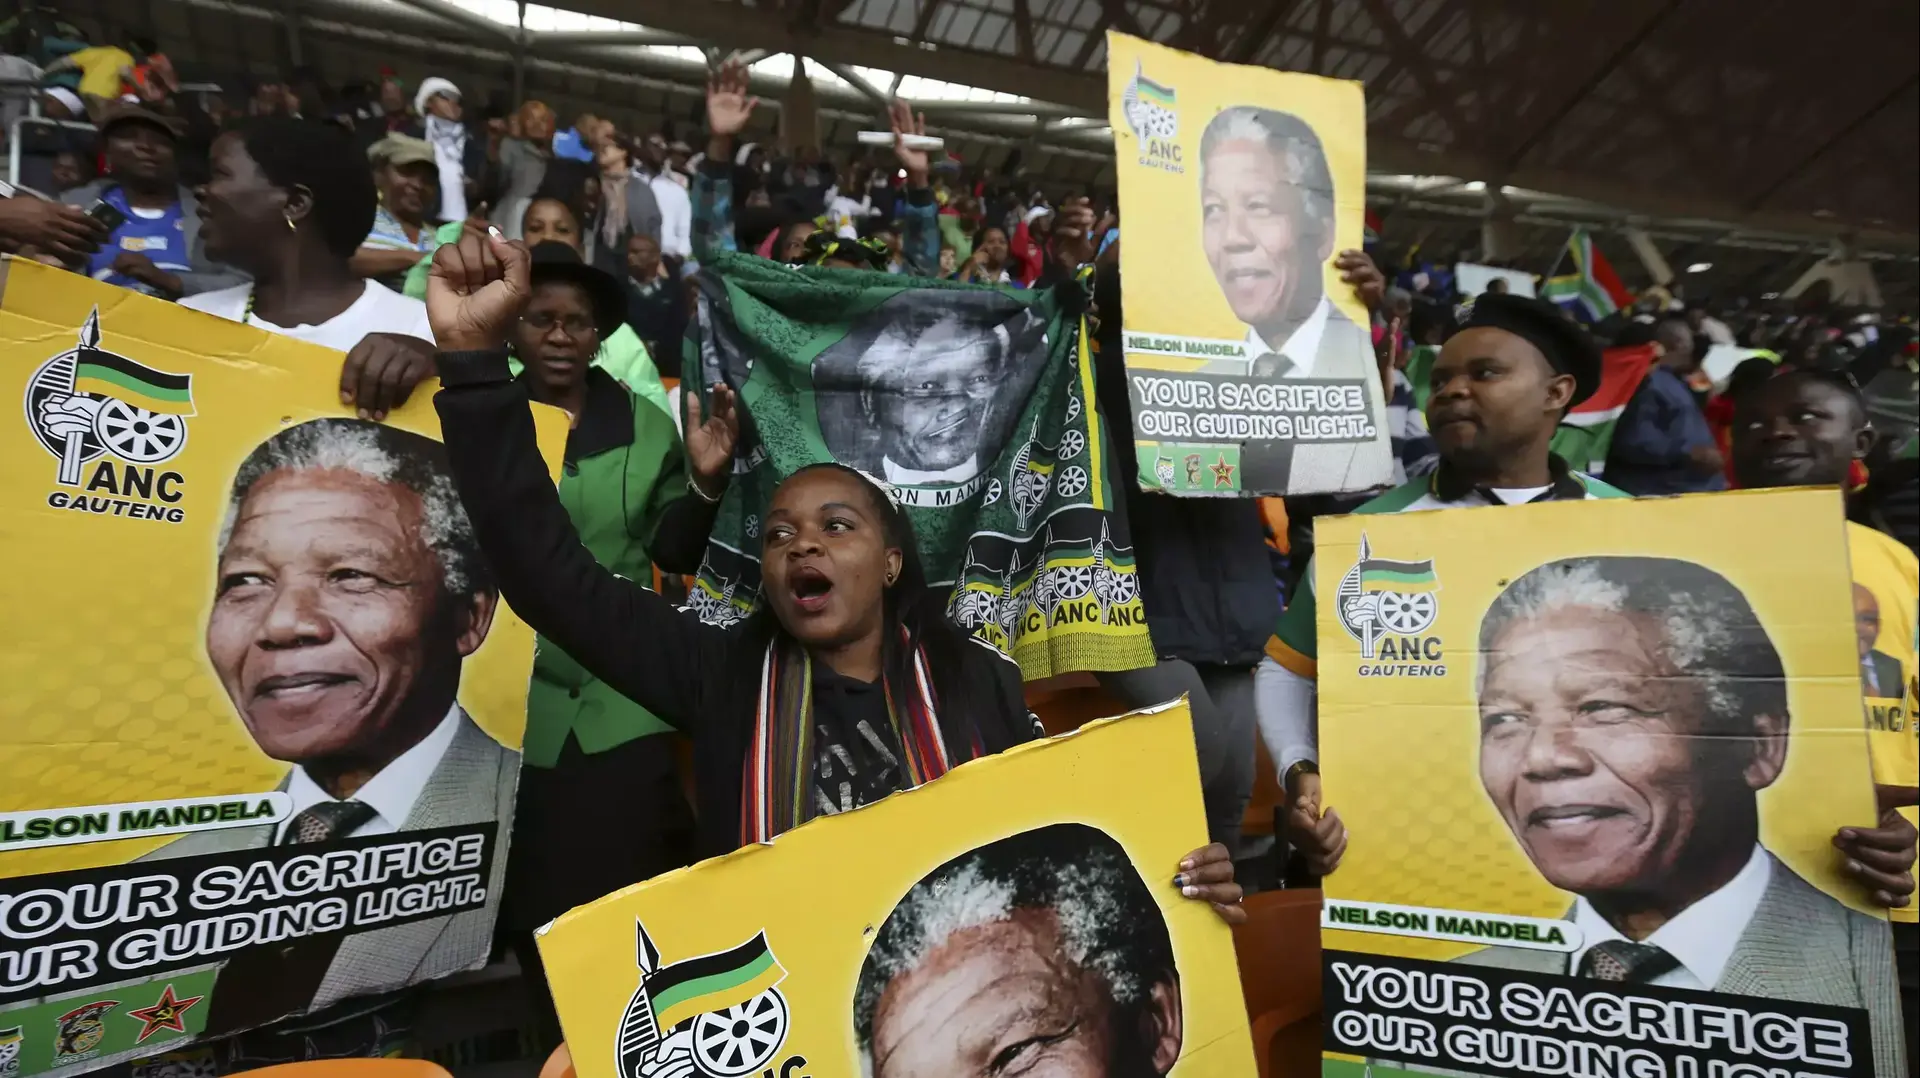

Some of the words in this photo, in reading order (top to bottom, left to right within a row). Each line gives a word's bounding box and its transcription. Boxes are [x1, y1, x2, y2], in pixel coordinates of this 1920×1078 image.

[1138, 157, 1185, 174] GAUTENG
[1149, 140, 1182, 161] ANC
[1128, 336, 1182, 353] NELSON
[1185, 341, 1246, 357] MANDELA
[1133, 376, 1215, 409] YOUR
[1217, 383, 1365, 412] SACRIFICE
[1138, 409, 1193, 436] OUR
[1194, 413, 1293, 439] GUIDING
[1295, 414, 1377, 439] LIGHT.
[86, 461, 184, 503] ANC
[48, 492, 185, 523] GAUTENG
[1053, 602, 1098, 626] ANC
[1379, 637, 1443, 661] ANC
[1358, 665, 1447, 677] GAUTENG
[1870, 704, 1902, 732] NC
[0, 812, 109, 843] LSON
[118, 798, 276, 832] MANDELA
[0, 873, 180, 939] OUR
[189, 833, 485, 910] SACRIFICE
[0, 939, 99, 993] UR
[108, 898, 348, 970] GUIDING
[353, 874, 486, 927] LIGHT.
[1328, 906, 1428, 931] NELSON
[1435, 915, 1567, 944] MANDELA
[1331, 962, 1493, 1020] YOUR
[1500, 982, 1852, 1068] SACRIFICE
[1332, 1009, 1439, 1058] OUR
[1443, 1024, 1669, 1078] GUIDING
